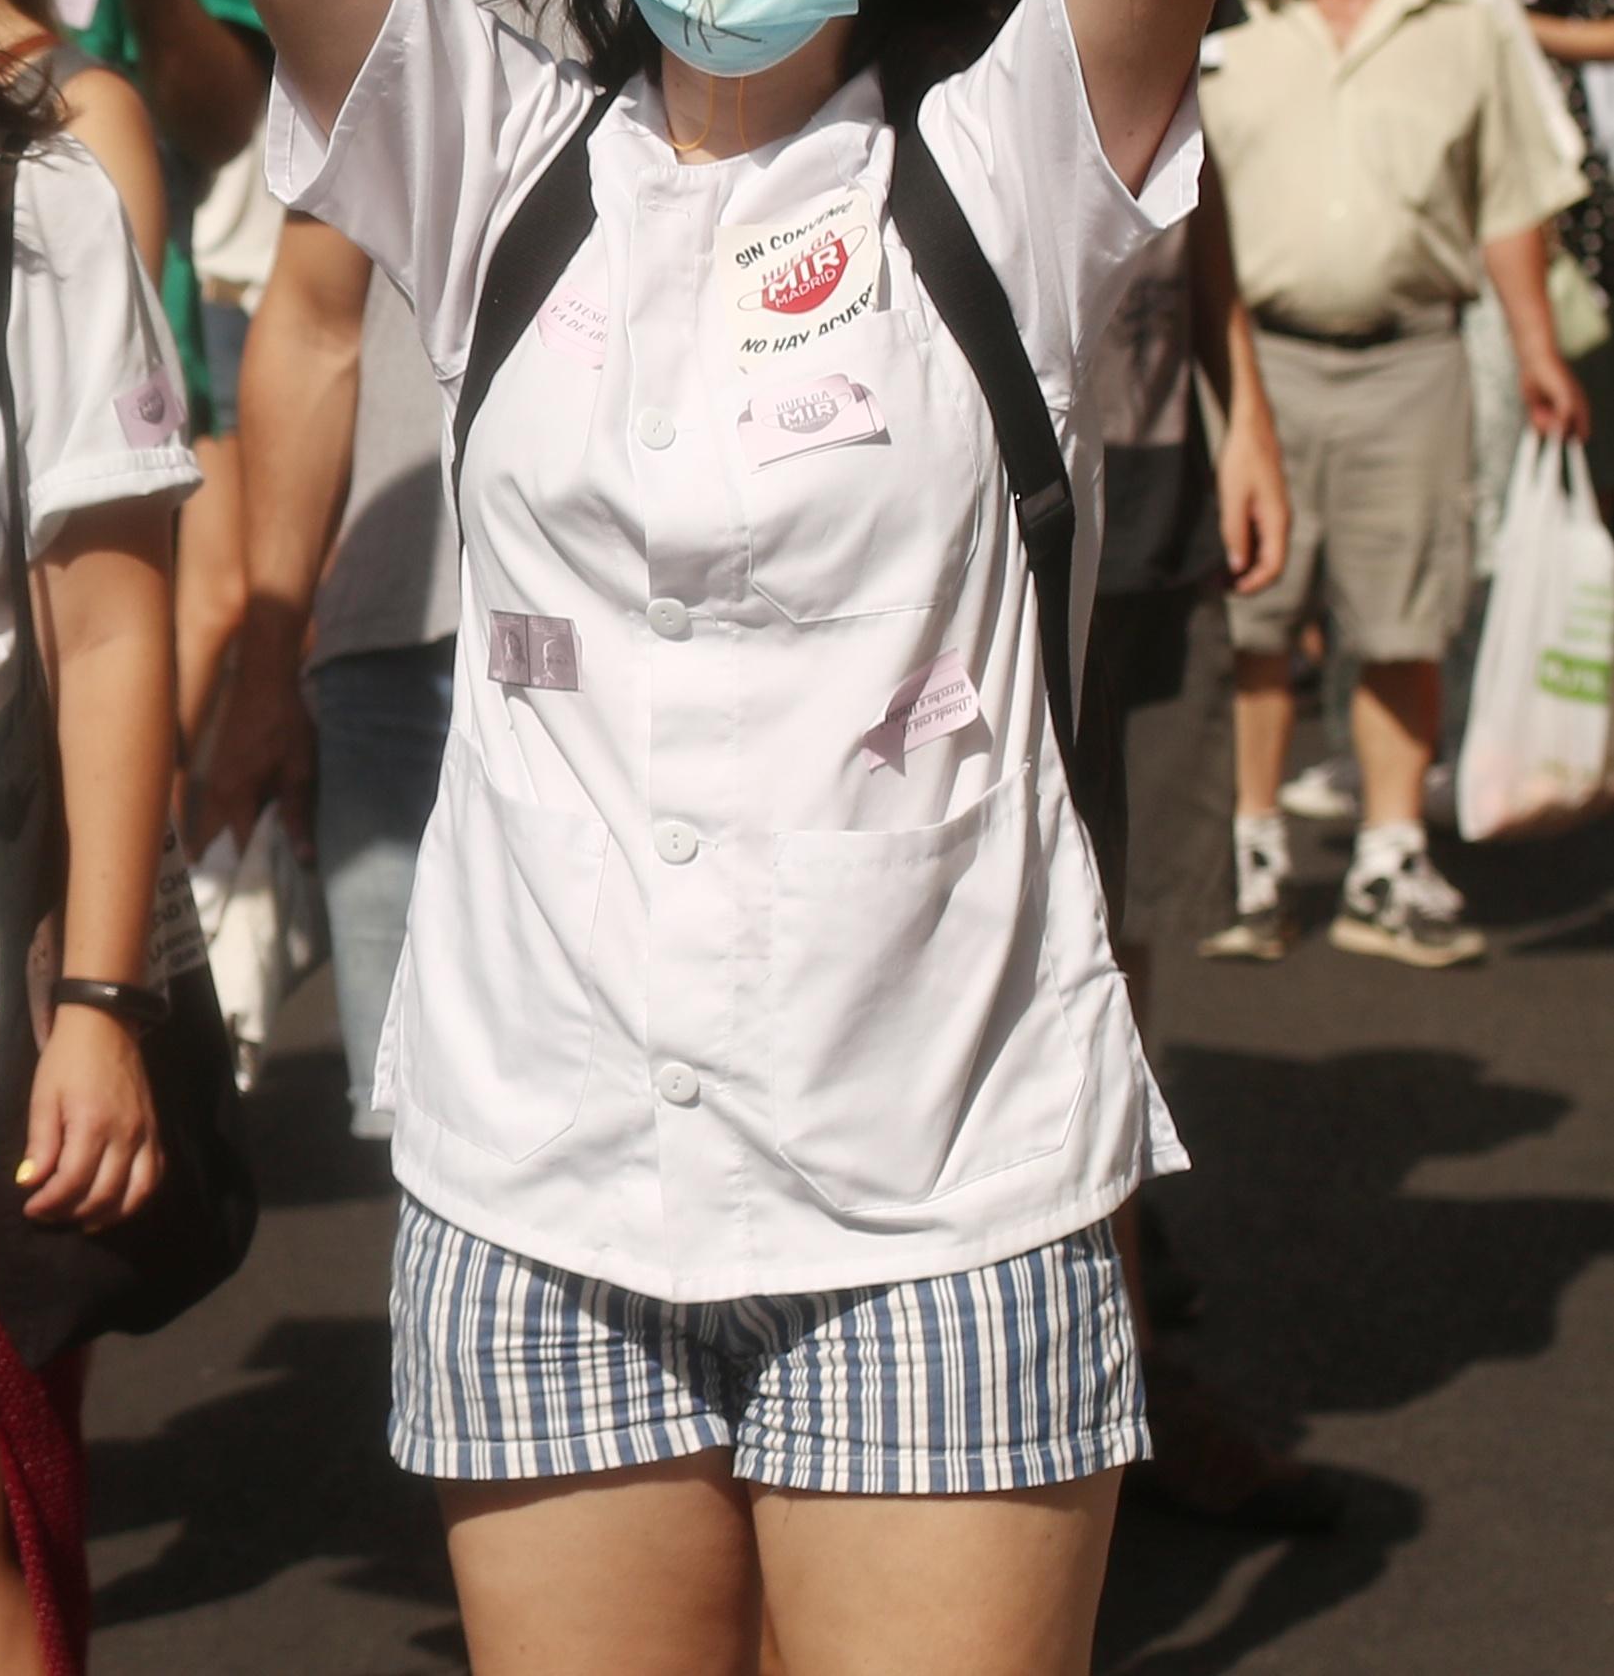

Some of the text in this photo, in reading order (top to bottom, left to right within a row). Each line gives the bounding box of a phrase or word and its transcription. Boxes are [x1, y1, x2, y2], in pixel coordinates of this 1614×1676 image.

[735, 241, 765, 270] SIN
[768, 244, 842, 302] MIR
[775, 268, 837, 309] MADRID
[740, 330, 811, 354] NO HAY
[783, 402, 834, 425] MIR
